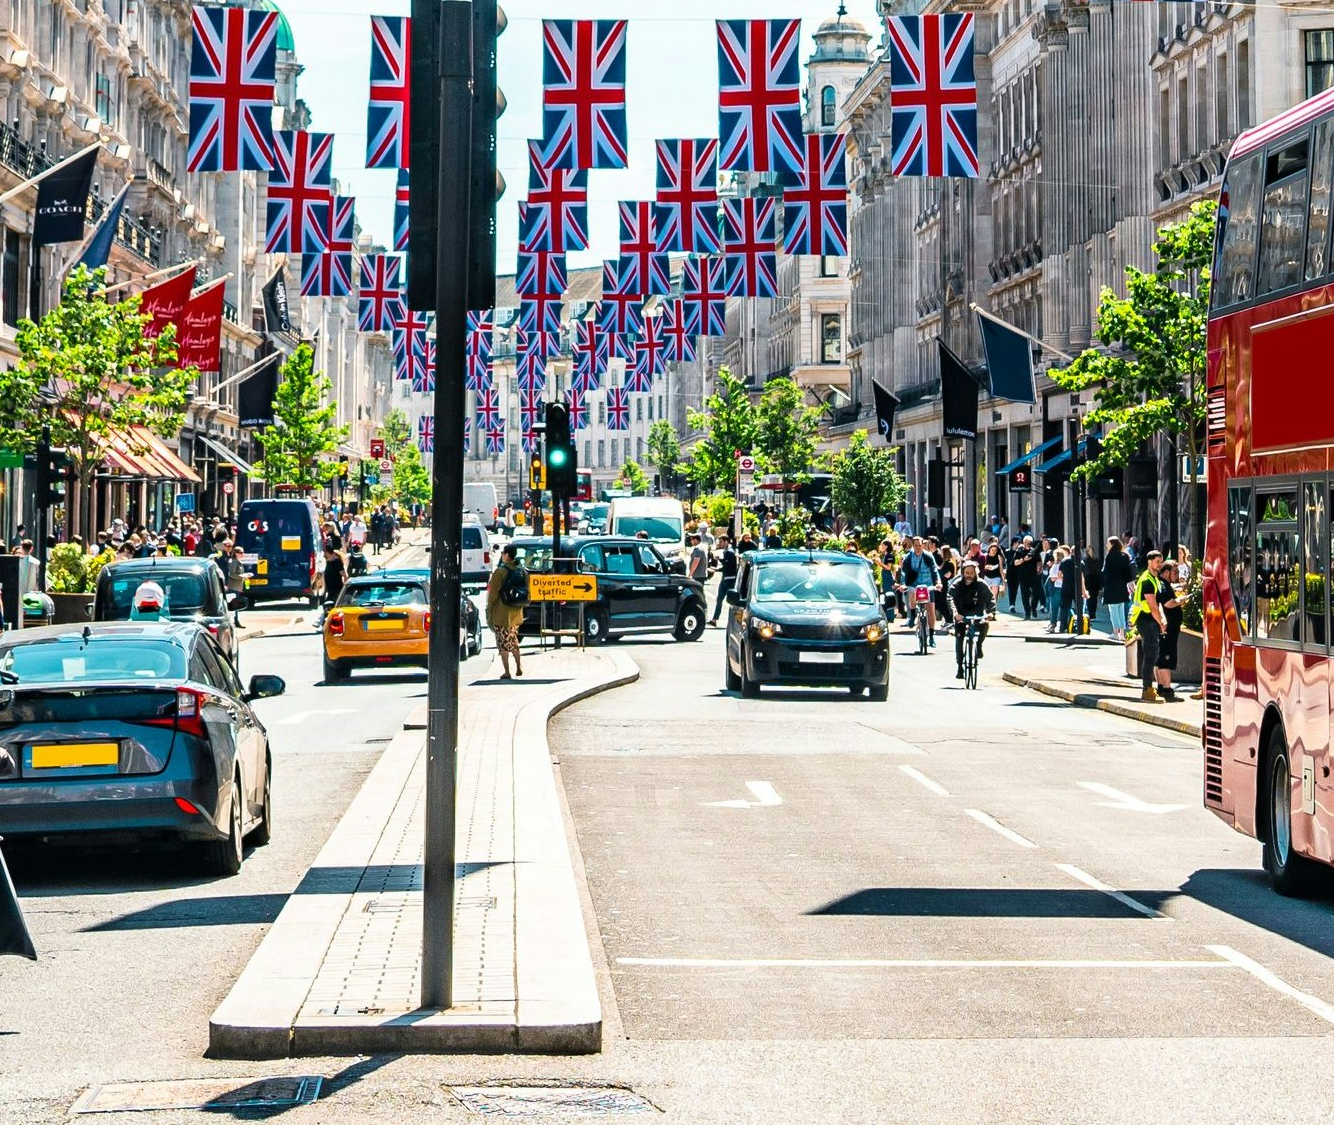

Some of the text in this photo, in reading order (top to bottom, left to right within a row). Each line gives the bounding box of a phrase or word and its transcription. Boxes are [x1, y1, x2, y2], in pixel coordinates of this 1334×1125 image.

[39, 206, 82, 215] COACH
[145, 297, 184, 314] Hamleys
[183, 311, 217, 327] Hamleys
[181, 332, 215, 348] Hamleys
[946, 427, 976, 438] lululemon
[248, 520, 269, 533] G4S
[532, 579, 572, 587] Diverted
